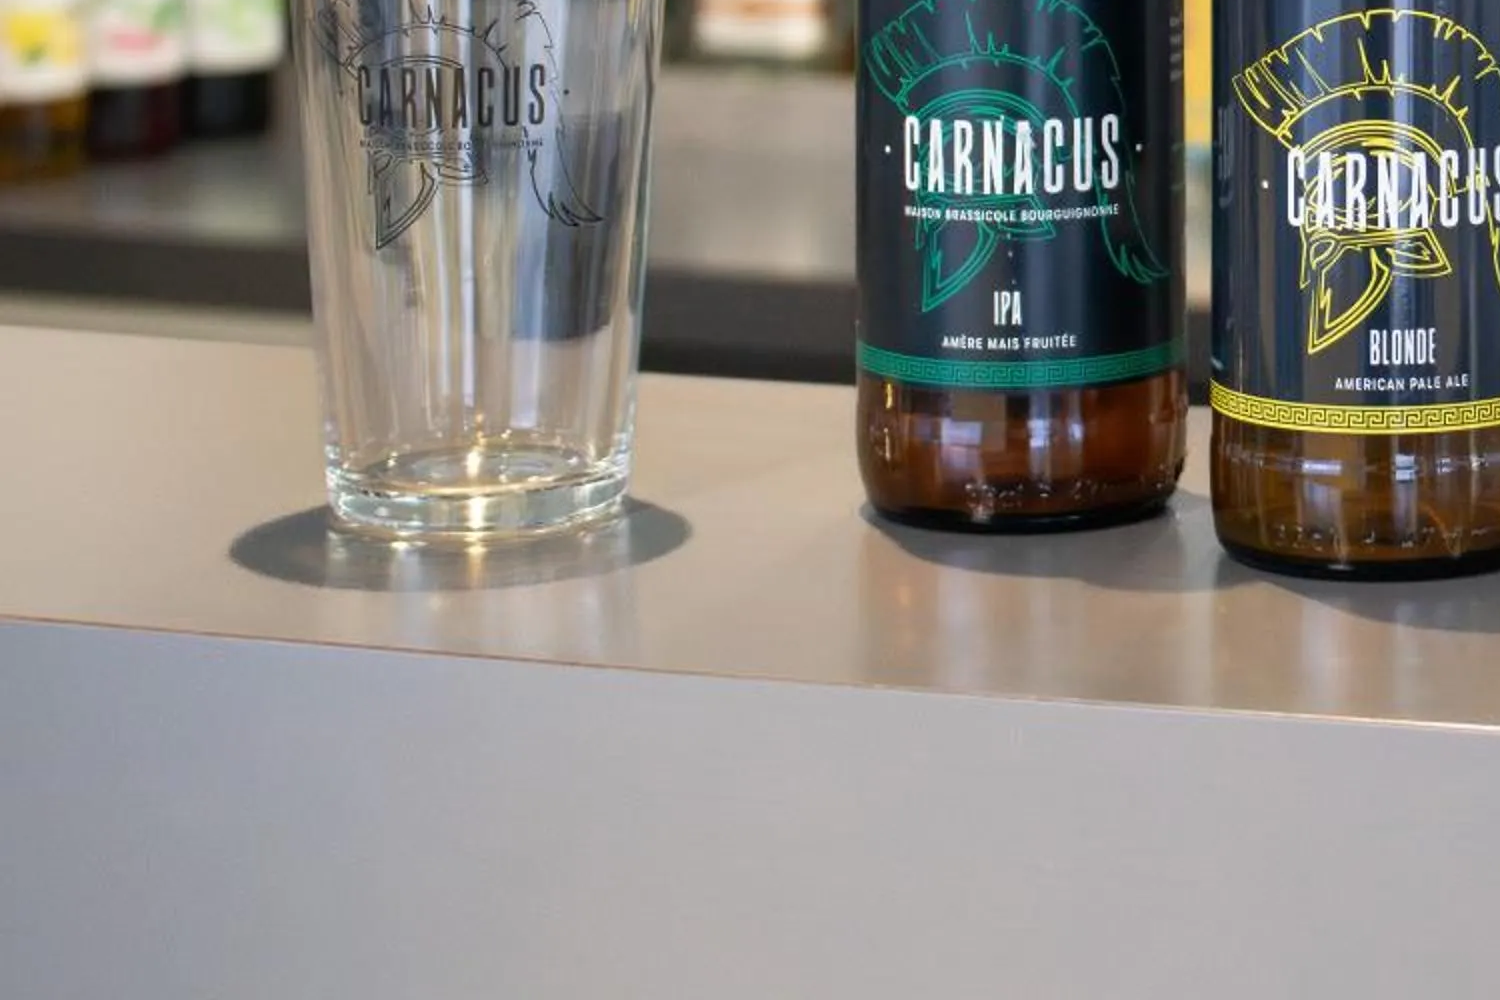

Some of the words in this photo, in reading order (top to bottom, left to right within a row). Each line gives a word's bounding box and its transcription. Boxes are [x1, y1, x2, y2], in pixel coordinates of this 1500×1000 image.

[357, 63, 545, 129] CARNACUS
[904, 114, 1120, 195] CARNACUS
[904, 205, 941, 220] MAISON
[944, 208, 1015, 222] BRASSICOLE
[1020, 203, 1119, 222] BOURGUIGNONNE
[993, 291, 1022, 325] IPA
[941, 334, 983, 349] AMÈRE
[987, 337, 1020, 350] MAIS
[1023, 333, 1077, 349] FRUITÉE
[1369, 328, 1436, 365] BLONDE
[1335, 377, 1405, 391] AMERICAN
[1409, 375, 1441, 390] PALE
[1445, 373, 1469, 388] ALE
